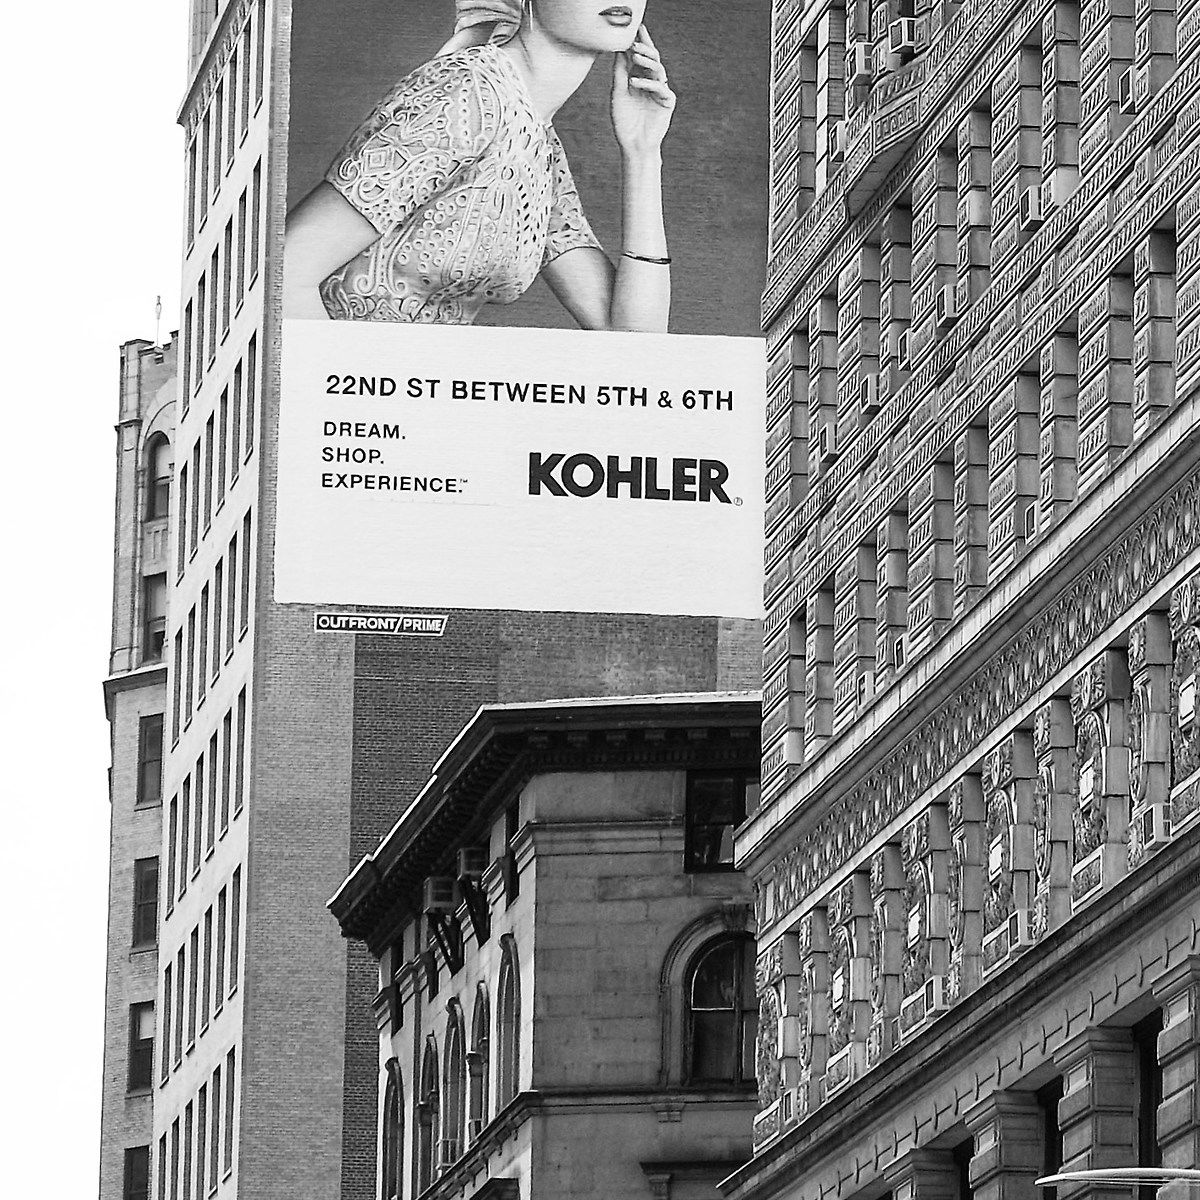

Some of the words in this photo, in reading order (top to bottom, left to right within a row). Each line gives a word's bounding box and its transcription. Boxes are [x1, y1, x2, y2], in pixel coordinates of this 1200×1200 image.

[325, 374, 397, 397] 22ND
[406, 377, 441, 399] ST
[451, 380, 586, 405] BETWEEN
[596, 385, 648, 408] 5TH
[657, 390, 674, 409] &
[681, 389, 733, 412] 6TH
[323, 420, 406, 440] DREAM.
[321, 446, 385, 465] SHOP.
